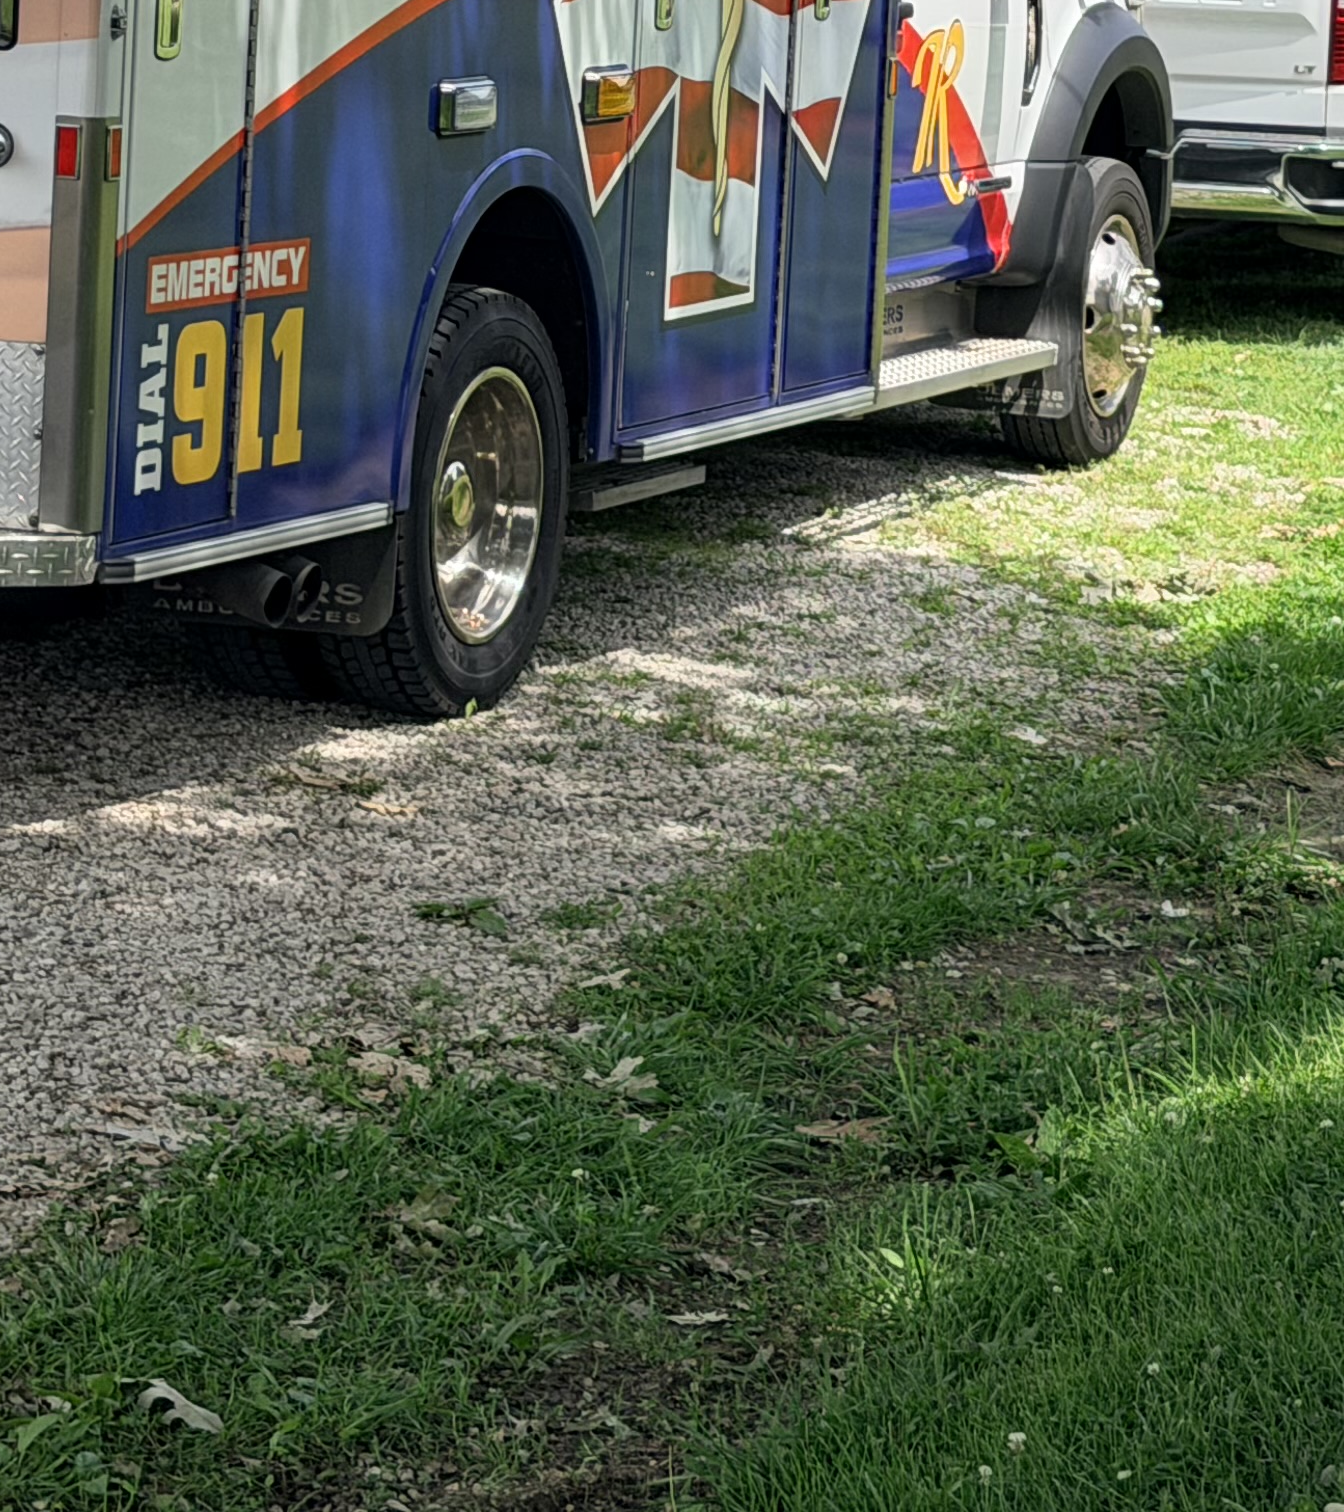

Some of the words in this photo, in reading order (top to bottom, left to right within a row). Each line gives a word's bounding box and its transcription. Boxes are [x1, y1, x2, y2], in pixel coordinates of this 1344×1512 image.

[149, 245, 307, 305] EMERGENCY
[133, 322, 170, 497] DIAL
[170, 306, 305, 486] 911
